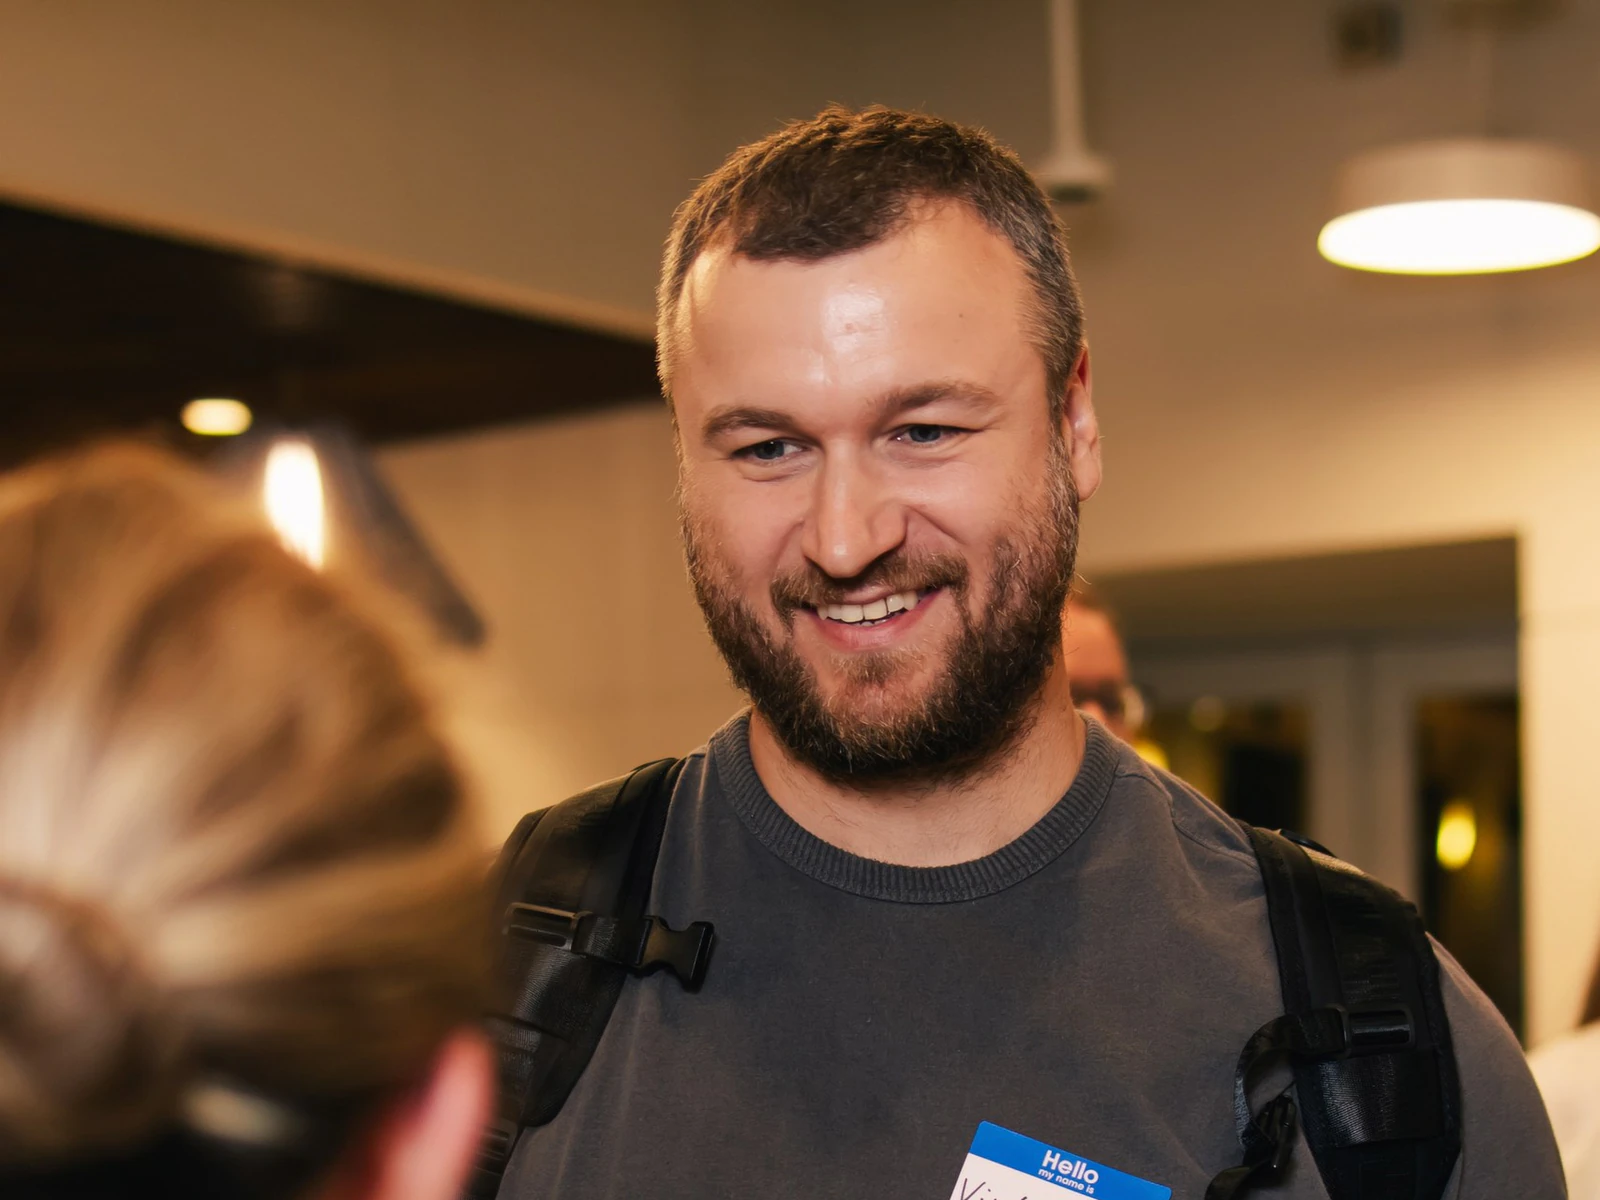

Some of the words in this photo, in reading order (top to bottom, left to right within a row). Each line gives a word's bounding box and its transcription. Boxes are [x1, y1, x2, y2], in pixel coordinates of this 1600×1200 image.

[1038, 1168, 1055, 1181] my
[1055, 1175, 1085, 1191] name
[1085, 1184, 1095, 1195] is
[1042, 1149, 1099, 1184] Hello
